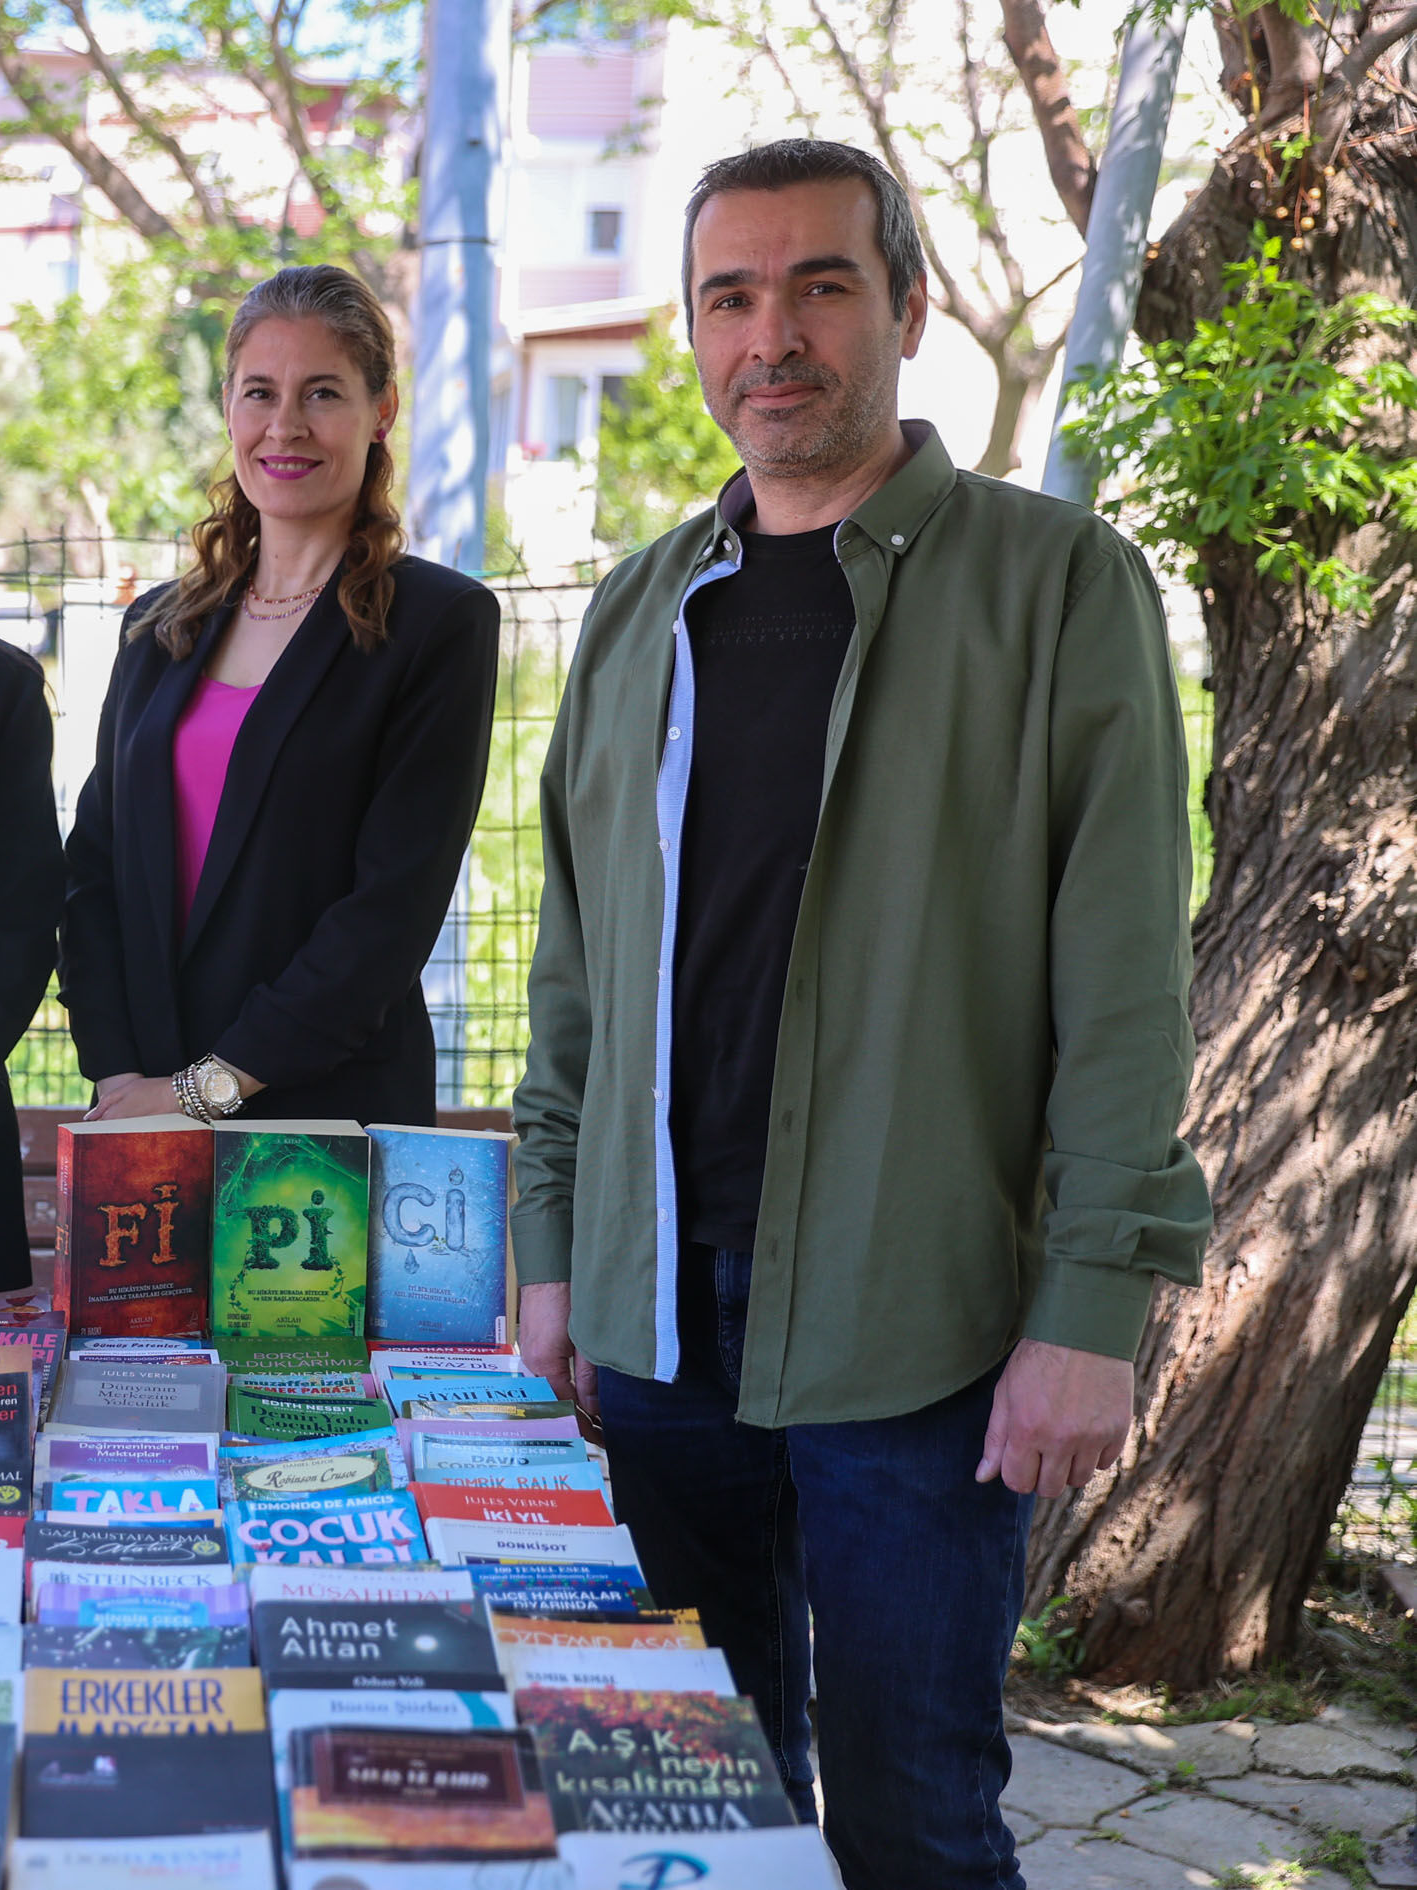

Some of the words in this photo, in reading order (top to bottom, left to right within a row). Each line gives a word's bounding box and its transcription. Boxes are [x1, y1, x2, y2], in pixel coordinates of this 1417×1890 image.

[253, 1350, 330, 1360] BORÇLU
[219, 1359, 365, 1369] OLDUKLARIMIZ
[411, 1359, 467, 1369] BEYAZ
[101, 1370, 135, 1378] JULES
[100, 1381, 177, 1393] Dünyanın
[417, 1390, 478, 1402] SİYAH
[485, 1387, 528, 1400] İNCİ
[97, 1390, 178, 1401] Merkezine
[103, 1398, 171, 1409] Yolculuk
[261, 1398, 302, 1410] EDITH
[305, 1404, 355, 1413] NESBIT
[251, 1405, 317, 1423] Demir
[317, 1412, 370, 1425] Yolu
[265, 1469, 318, 1489] Robinson
[320, 1467, 358, 1483] Crusoe
[63, 1488, 205, 1513] TAKLA
[250, 1500, 322, 1512] EDMONDO
[324, 1500, 344, 1509] DE
[346, 1495, 395, 1508] AMICIS
[465, 1495, 504, 1506] JULES
[508, 1498, 558, 1508] VERNE
[482, 1508, 513, 1522] İKİ
[515, 1511, 550, 1524] YIL
[39, 1527, 78, 1539] GAZİ
[82, 1530, 156, 1542] MUSTAFA
[159, 1533, 210, 1543] KEMAL
[497, 1540, 568, 1553] DONKİŞOT
[77, 1572, 214, 1587] STEINBECK
[531, 1587, 622, 1601] HARİKALAR
[281, 1616, 399, 1639] Ahmet
[282, 1637, 380, 1659] Altan
[59, 1678, 225, 1716] ERKEKLER
[661, 1752, 760, 1779] neyin
[556, 1771, 754, 1796] kısaltması
[585, 1799, 753, 1829] AGATHA
